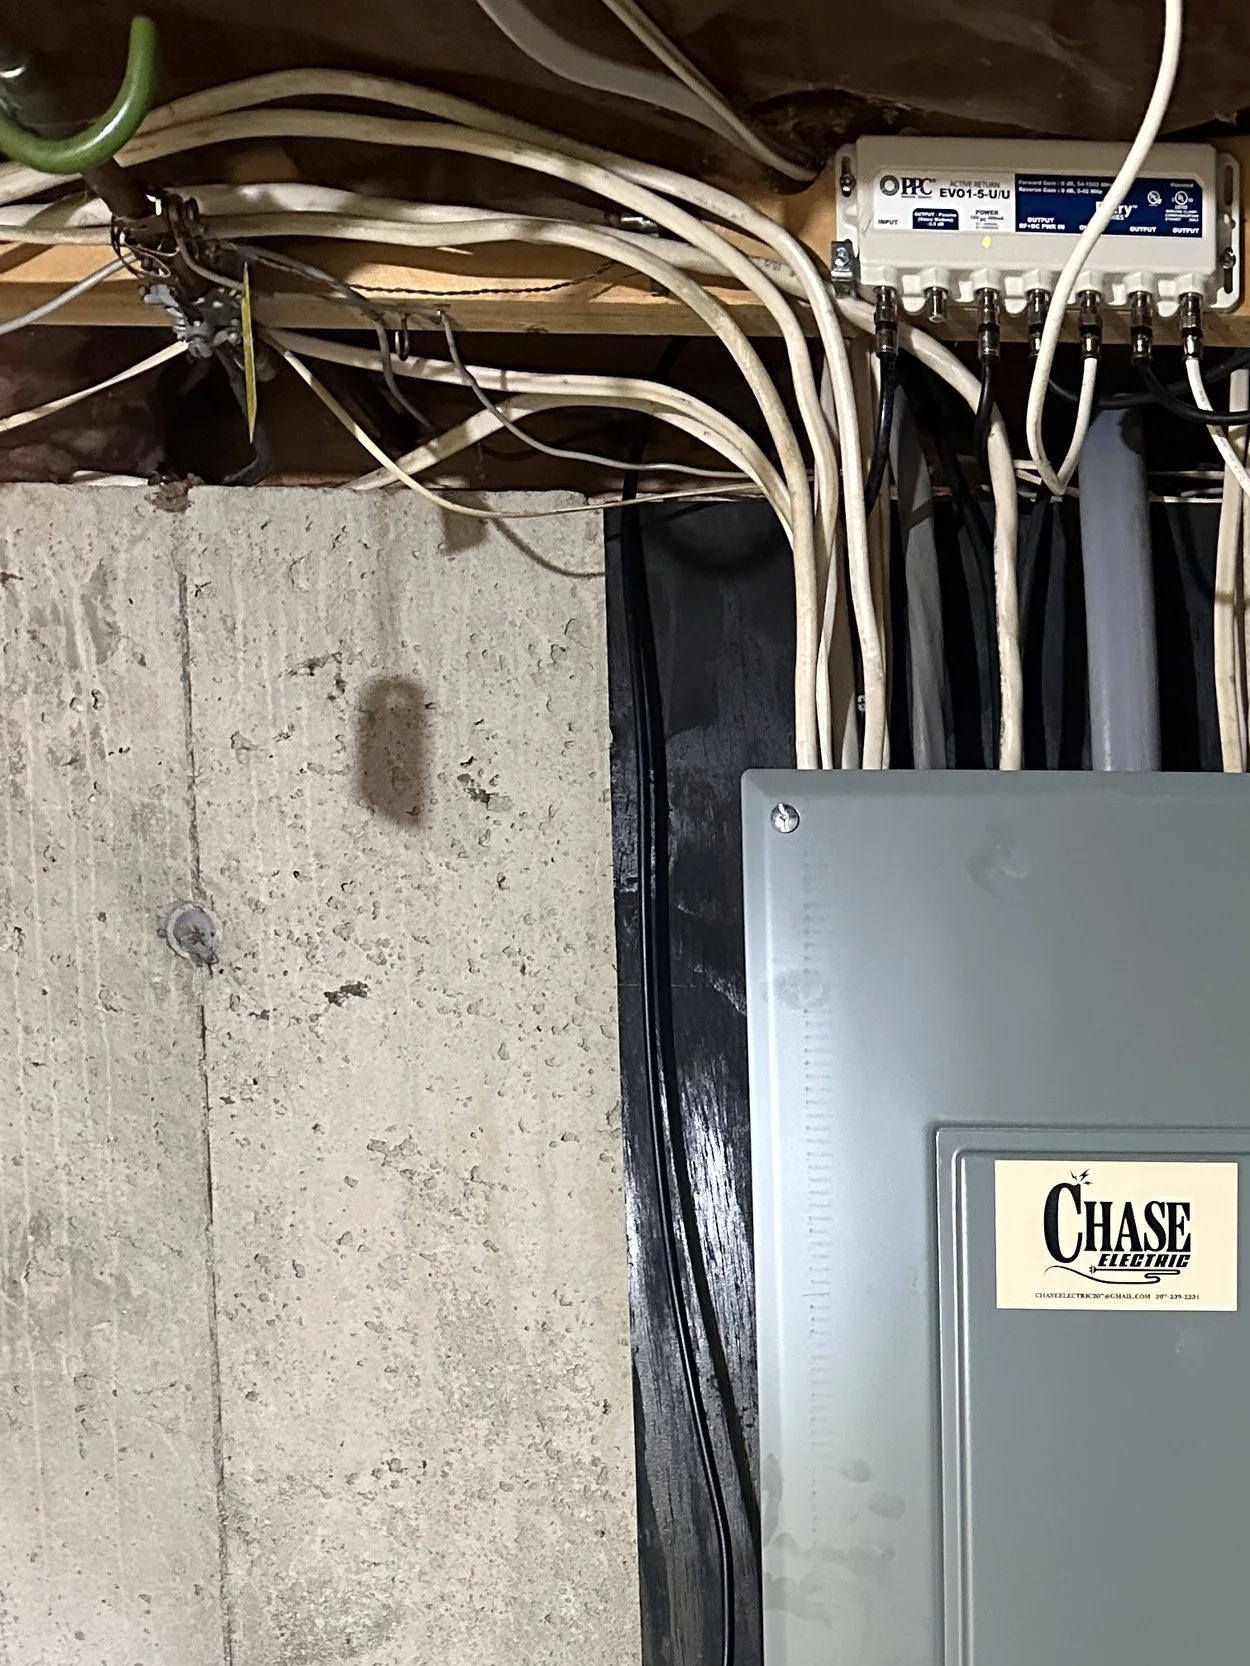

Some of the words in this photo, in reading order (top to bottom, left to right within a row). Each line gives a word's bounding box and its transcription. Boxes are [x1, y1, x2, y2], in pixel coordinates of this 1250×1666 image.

[901, 177, 933, 195] PPC
[950, 180, 973, 188] ACTIVE
[974, 181, 1000, 189] RETURN
[1027, 216, 1055, 224] OUTPUT
[1097, 1253, 1192, 1268] ELECTRIC
